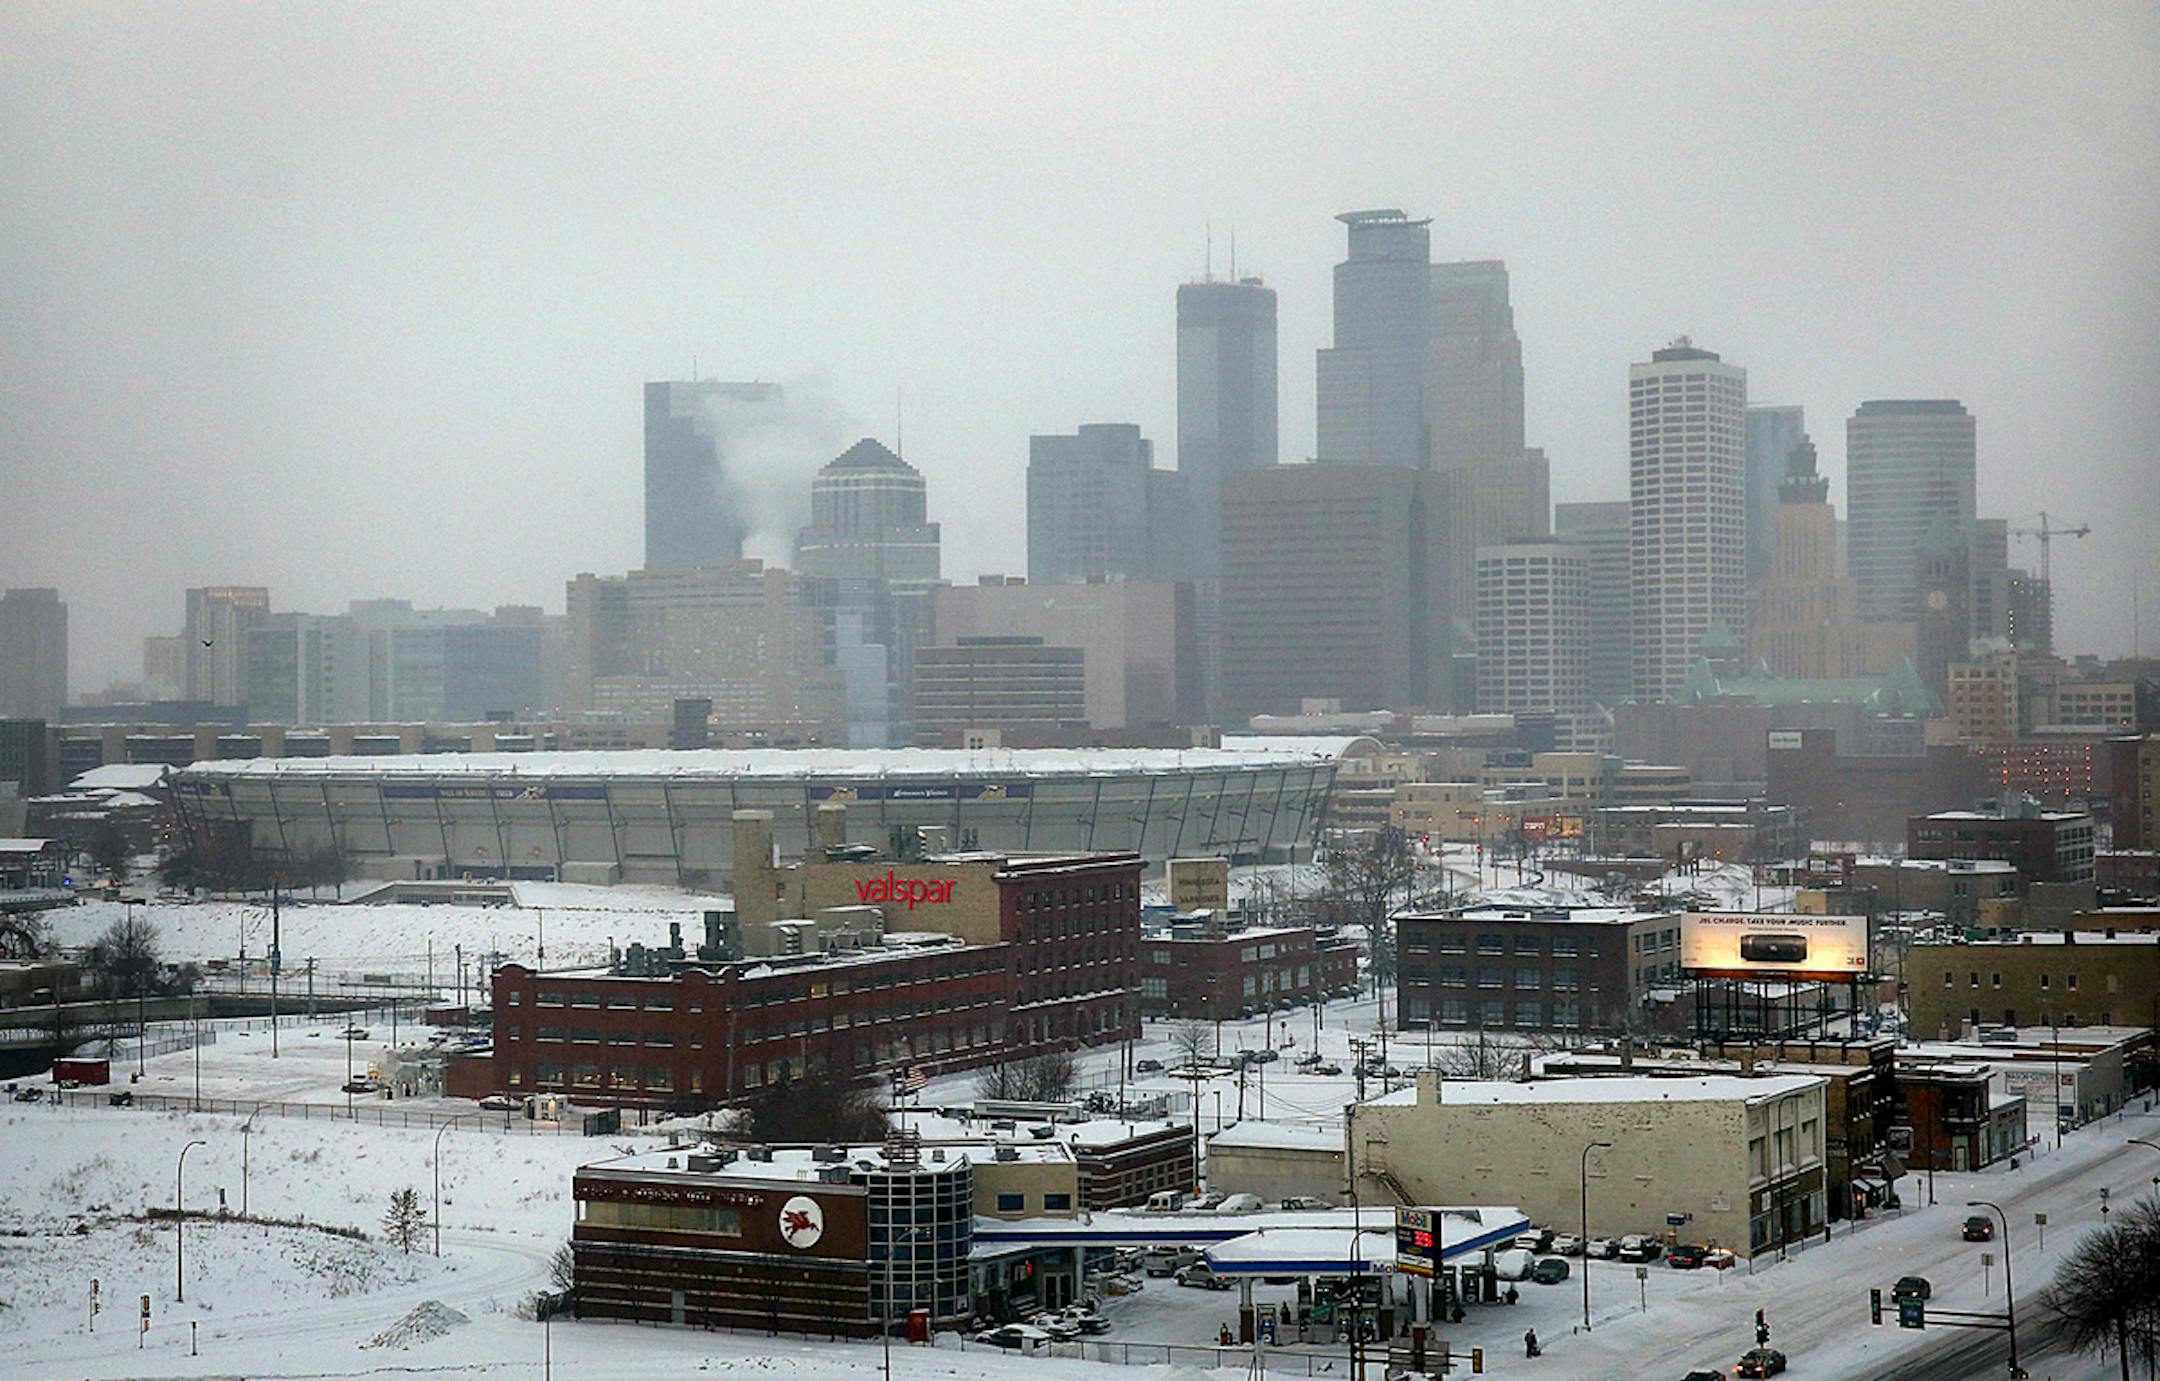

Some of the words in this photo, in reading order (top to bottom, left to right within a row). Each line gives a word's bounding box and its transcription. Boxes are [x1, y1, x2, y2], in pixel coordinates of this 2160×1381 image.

[854, 870, 957, 910] valspar
[1766, 918, 1786, 926] YOUR
[1401, 1210, 1428, 1229] Mobil
